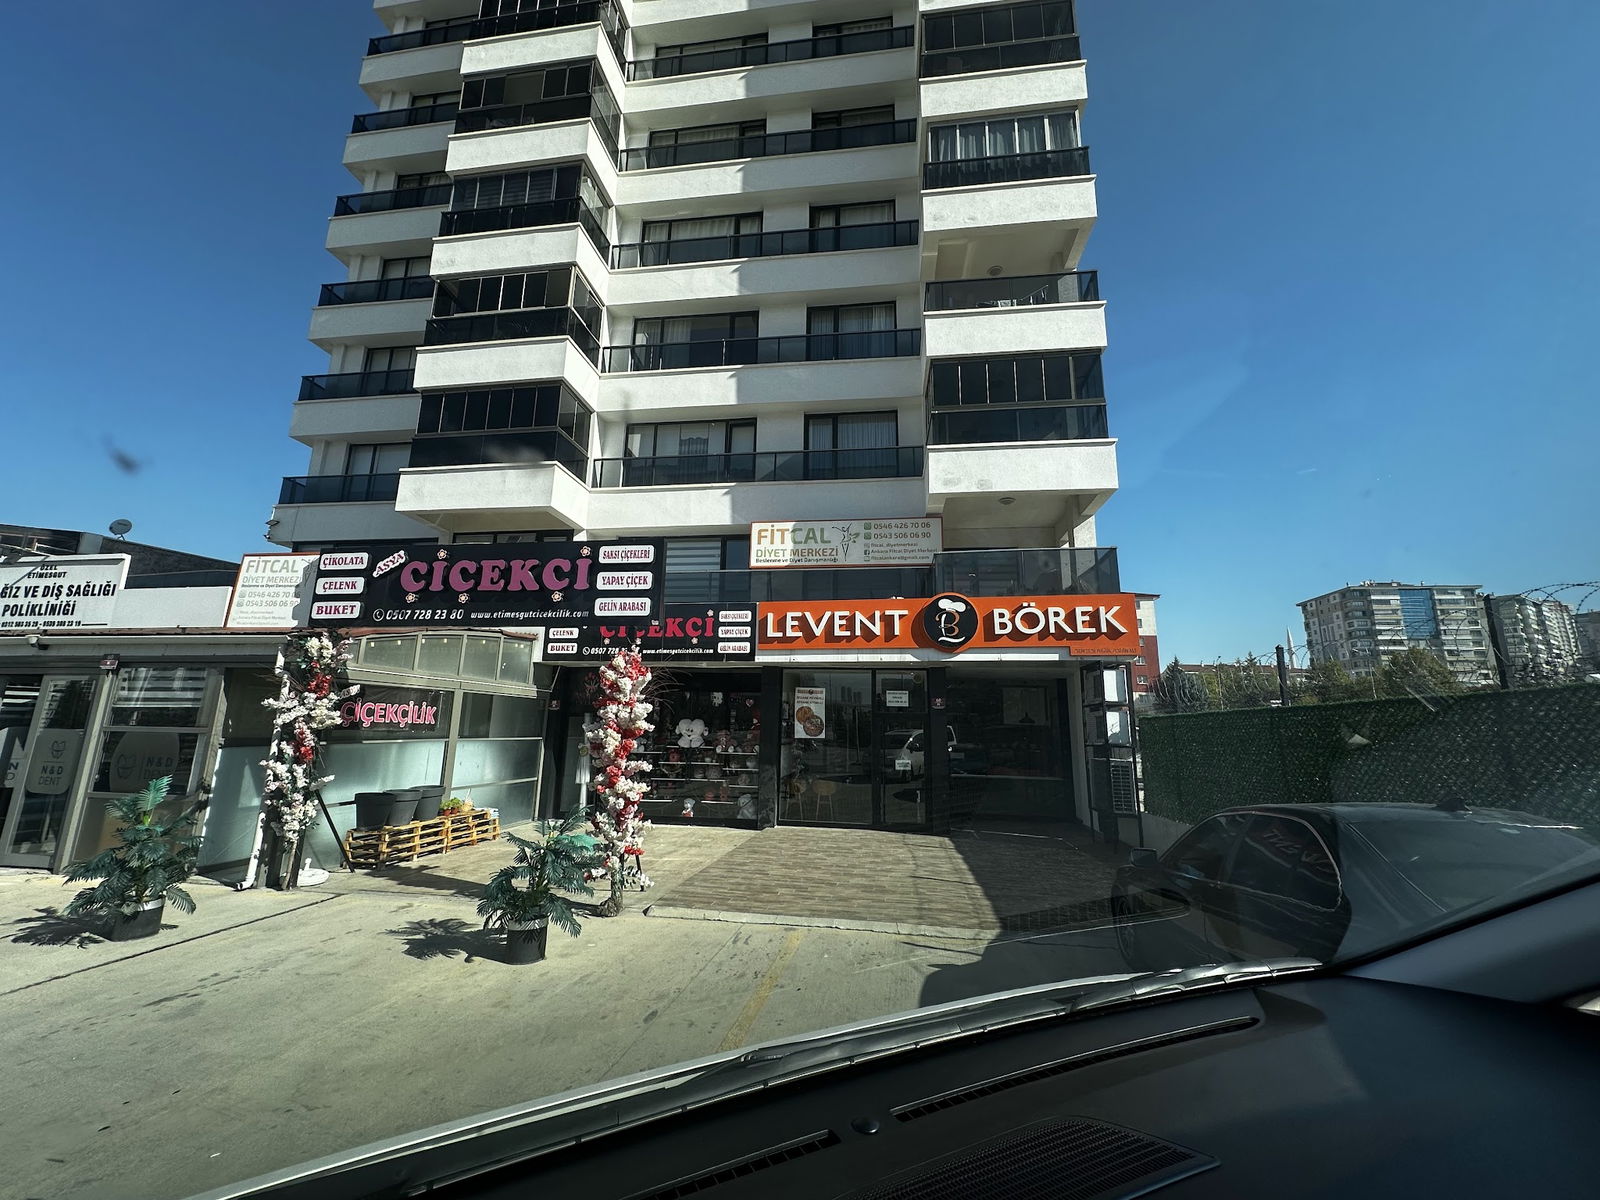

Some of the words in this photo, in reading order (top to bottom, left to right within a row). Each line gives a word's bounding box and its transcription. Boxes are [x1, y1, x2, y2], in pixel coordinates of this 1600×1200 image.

[757, 524, 831, 544] FİTCAL
[602, 550, 619, 559] SAKSI
[620, 547, 650, 562] ÇİÇEKLERİ
[756, 547, 787, 558] DİYET
[790, 546, 838, 557] MERKEZİ
[246, 557, 299, 573] FİTCAL
[322, 556, 364, 568] ÇİKOLATA
[376, 553, 404, 576] ASYA
[242, 575, 265, 583] DİYET
[602, 576, 625, 585] YAPAY
[626, 573, 649, 587] ÇİÇEK
[0, 584, 21, 598] ĞIZ
[24, 586, 40, 598] VE
[42, 583, 63, 600] DİŞ
[66, 581, 116, 597] SAĞLIĞI
[322, 581, 357, 592] ÇELENK
[2, 600, 76, 617] POLİKLİNİĞİ
[316, 605, 356, 615] BUKET
[599, 600, 618, 612] GELİN
[619, 602, 646, 611] ARABASI
[386, 610, 411, 620] 0507
[414, 609, 431, 620] 728
[434, 609, 447, 619] 23
[449, 609, 464, 619] 80
[470, 608, 589, 621] www.etimesgutcicekcilik.com
[767, 610, 909, 637] LEVENT
[992, 602, 1128, 635] BÖREK
[340, 698, 437, 727] ÇİÇEKÇİLİK
[41, 765, 48, 774] N
[57, 766, 63, 774] D
[39, 776, 62, 785] DENT
